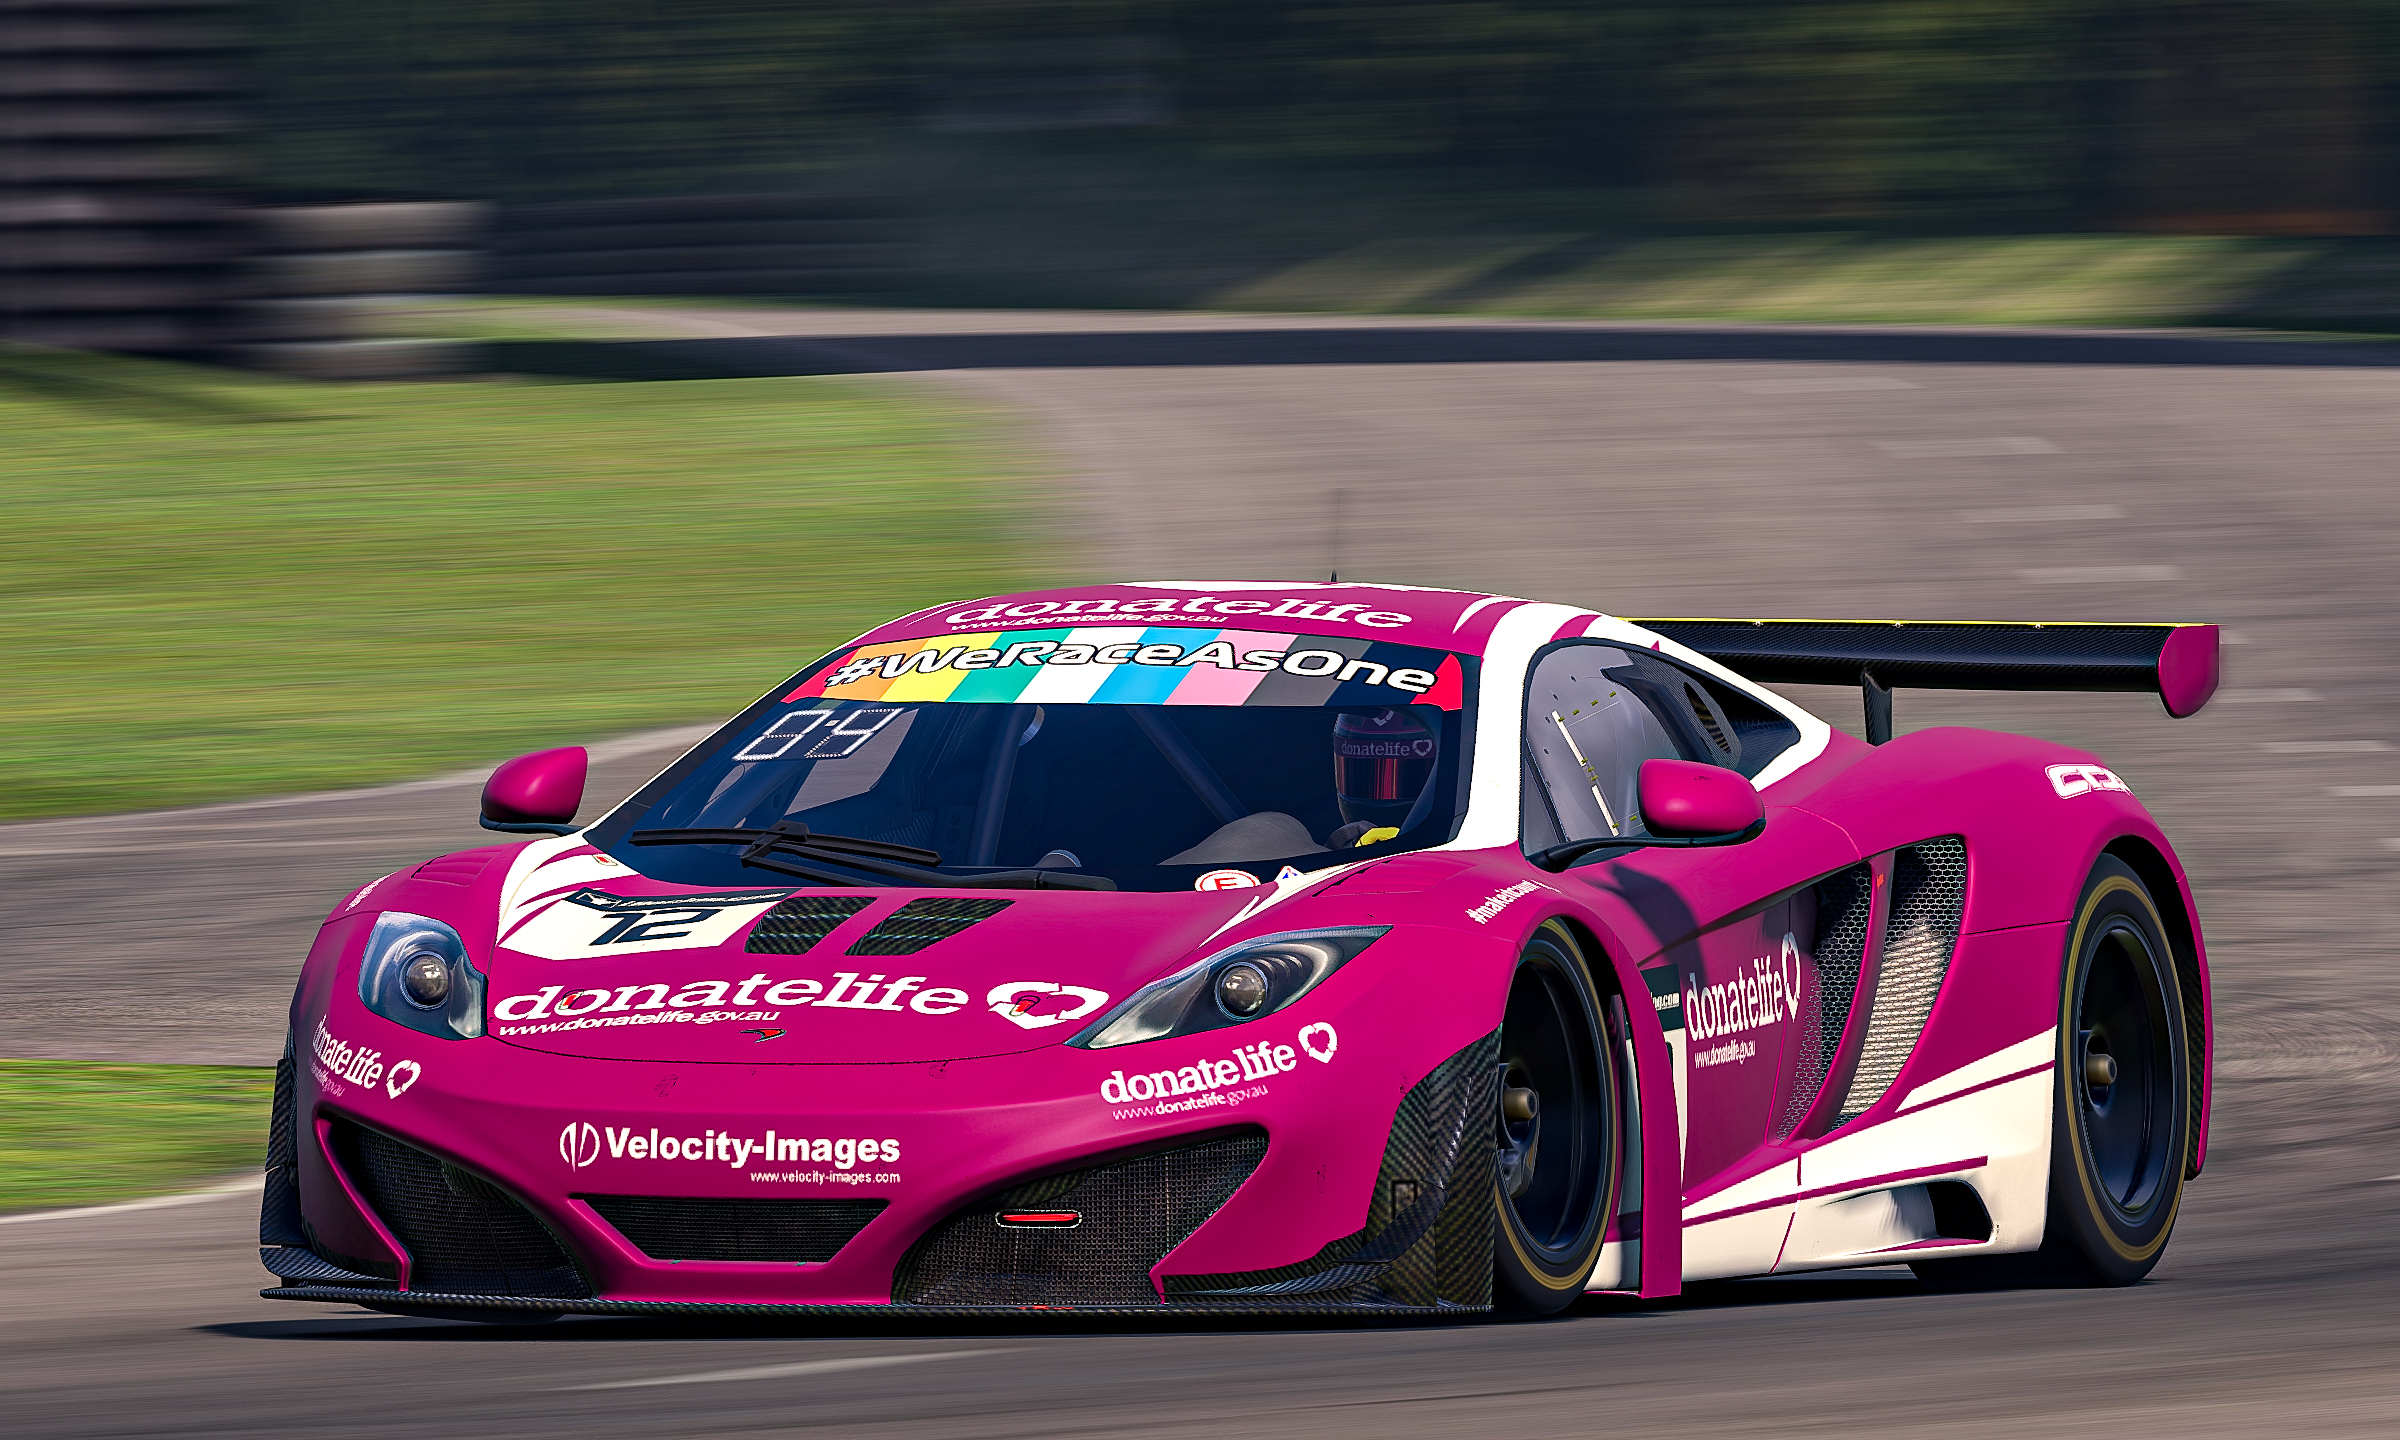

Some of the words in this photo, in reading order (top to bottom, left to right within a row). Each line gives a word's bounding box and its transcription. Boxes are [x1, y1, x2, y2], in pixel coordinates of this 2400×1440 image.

[946, 597, 1412, 629] donatelife
[951, 612, 1228, 631] www.donatelife.gov.au
[824, 641, 1439, 694] #WeRaceAsOne
[1342, 740, 1410, 756] donatelife
[493, 972, 969, 1021] donatelife
[1687, 955, 1783, 1041] donatelife
[499, 1010, 781, 1037] www.donatelife.gov.au
[1113, 1084, 1268, 1119] www.donatelife.gov.au
[605, 1127, 900, 1169] Velocity-Images
[750, 1170, 900, 1186] www.velocity-images.com
